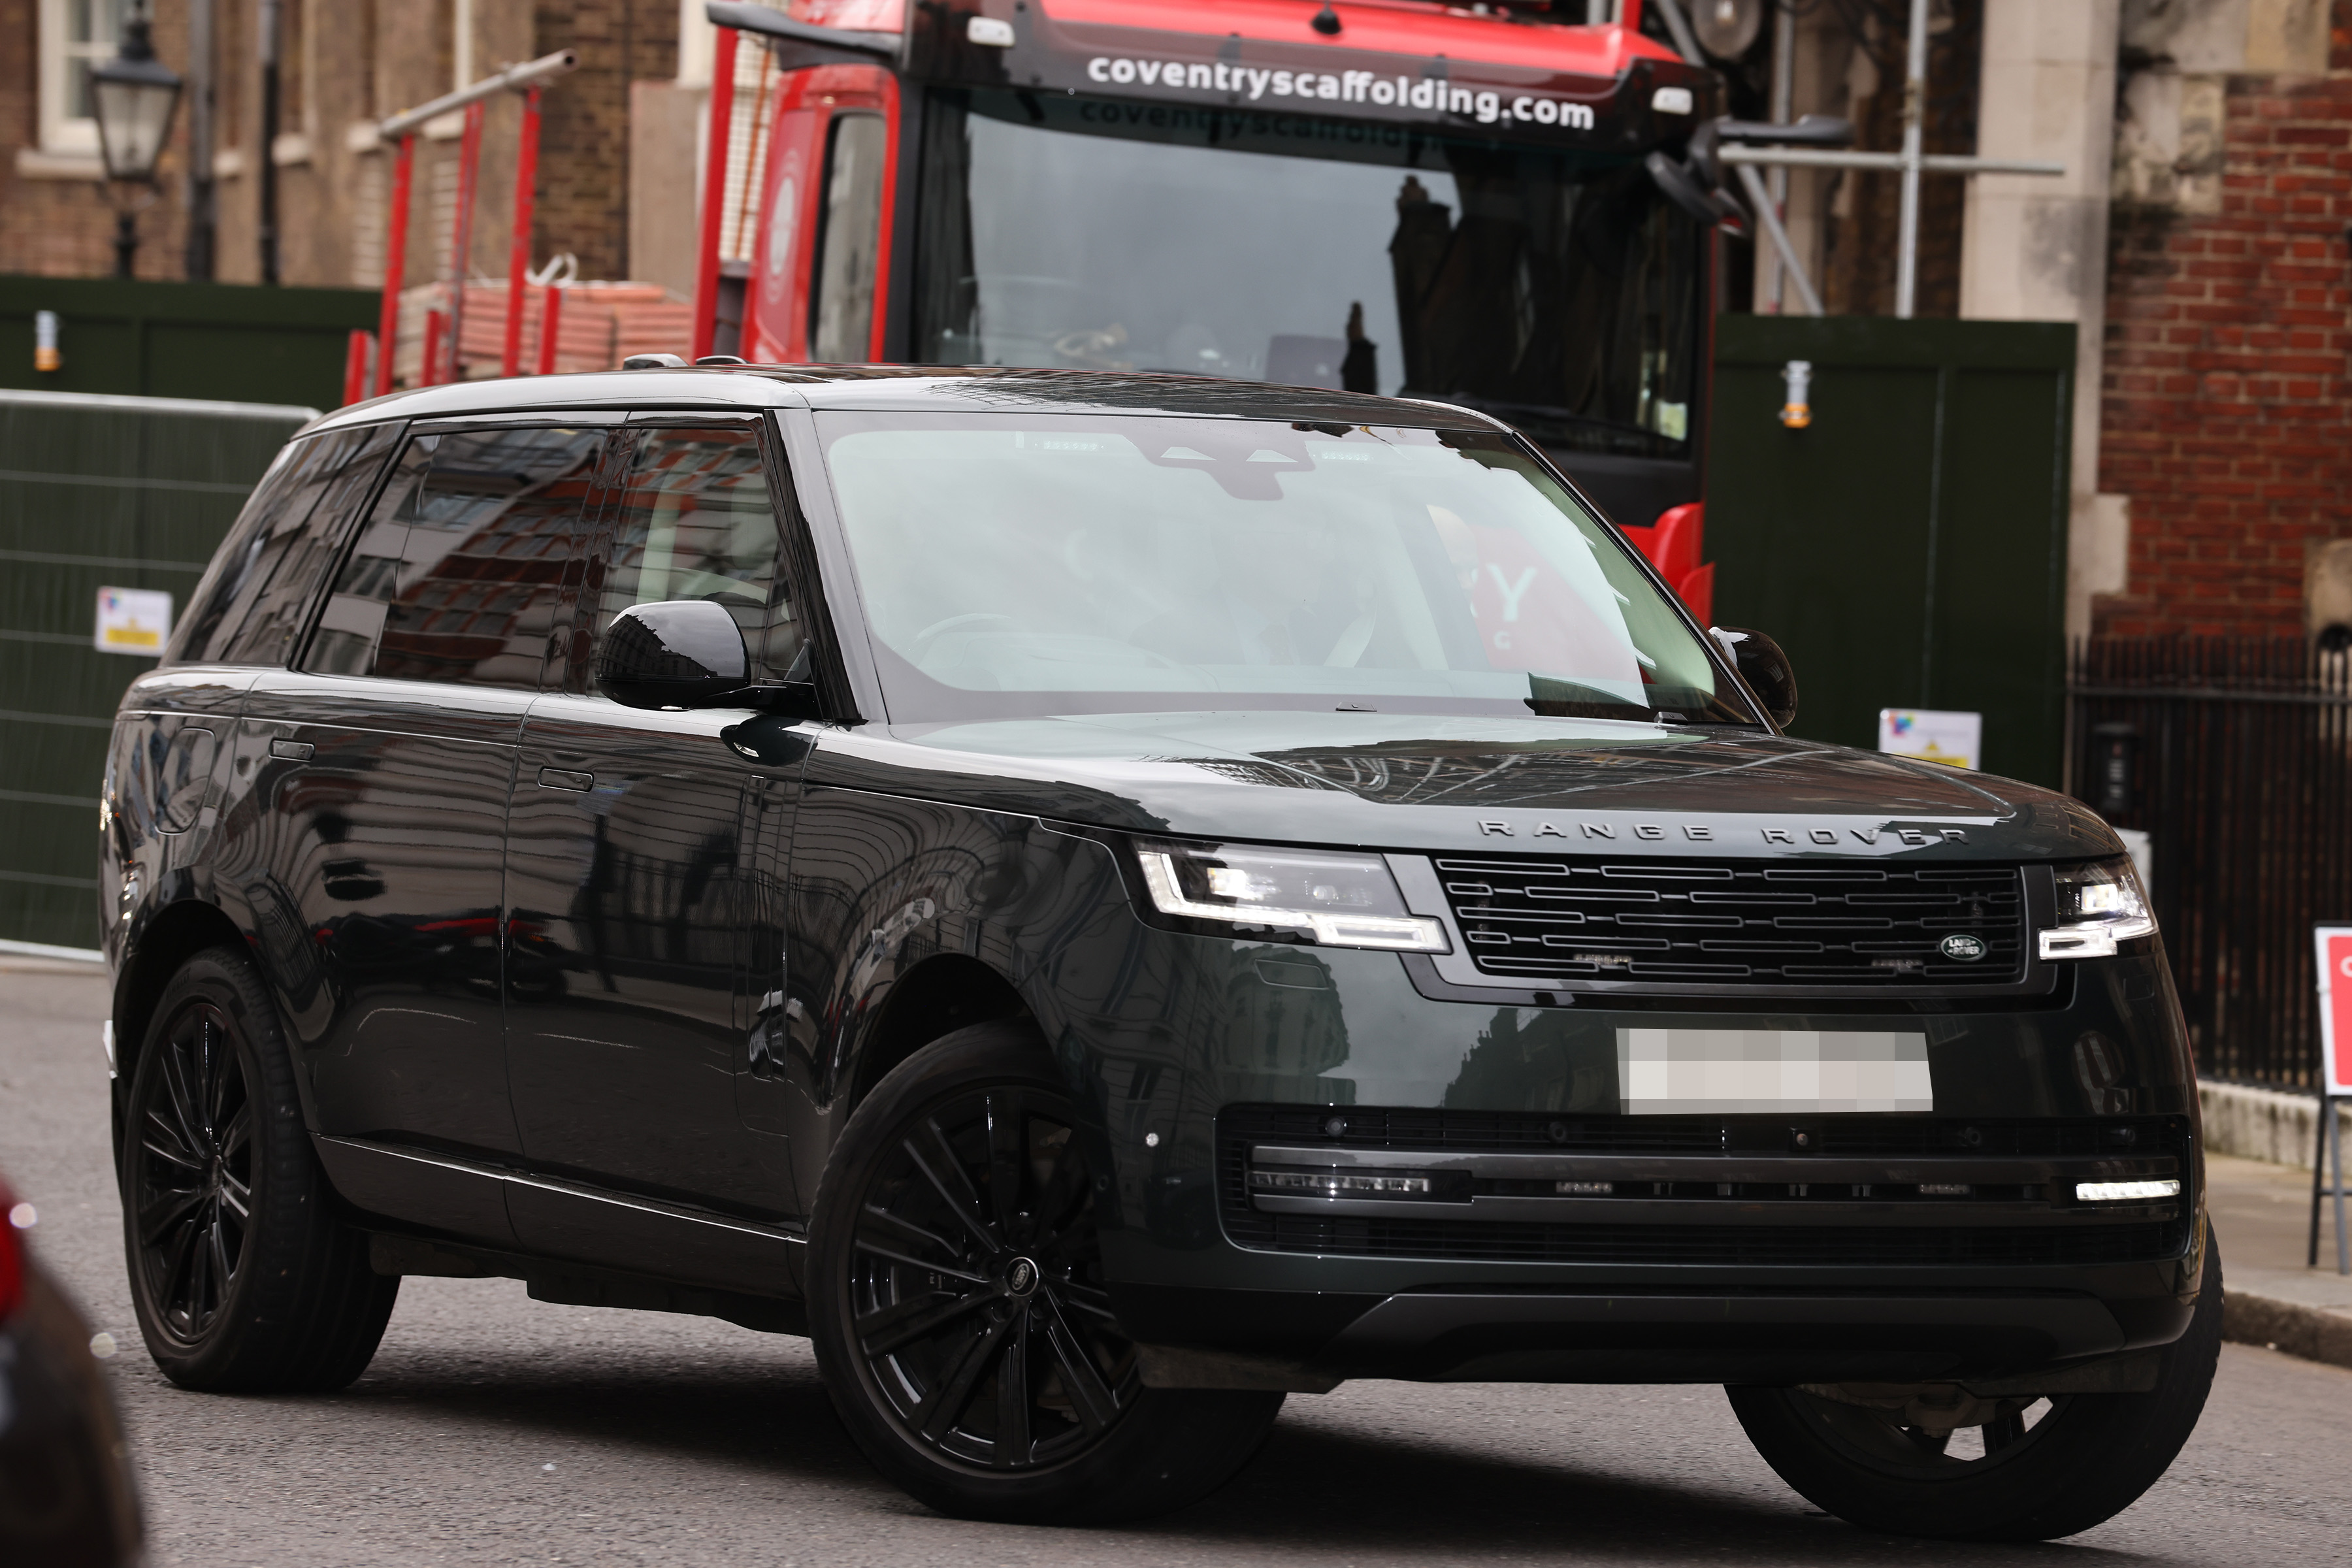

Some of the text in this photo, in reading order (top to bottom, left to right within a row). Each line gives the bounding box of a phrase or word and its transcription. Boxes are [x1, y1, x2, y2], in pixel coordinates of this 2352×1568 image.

[1088, 57, 1594, 129] coventryscaffolding.com
[1478, 820, 1969, 845] RANGE ROVER
[1948, 938, 1972, 947] LAND
[1953, 945, 1980, 955] ROVER
